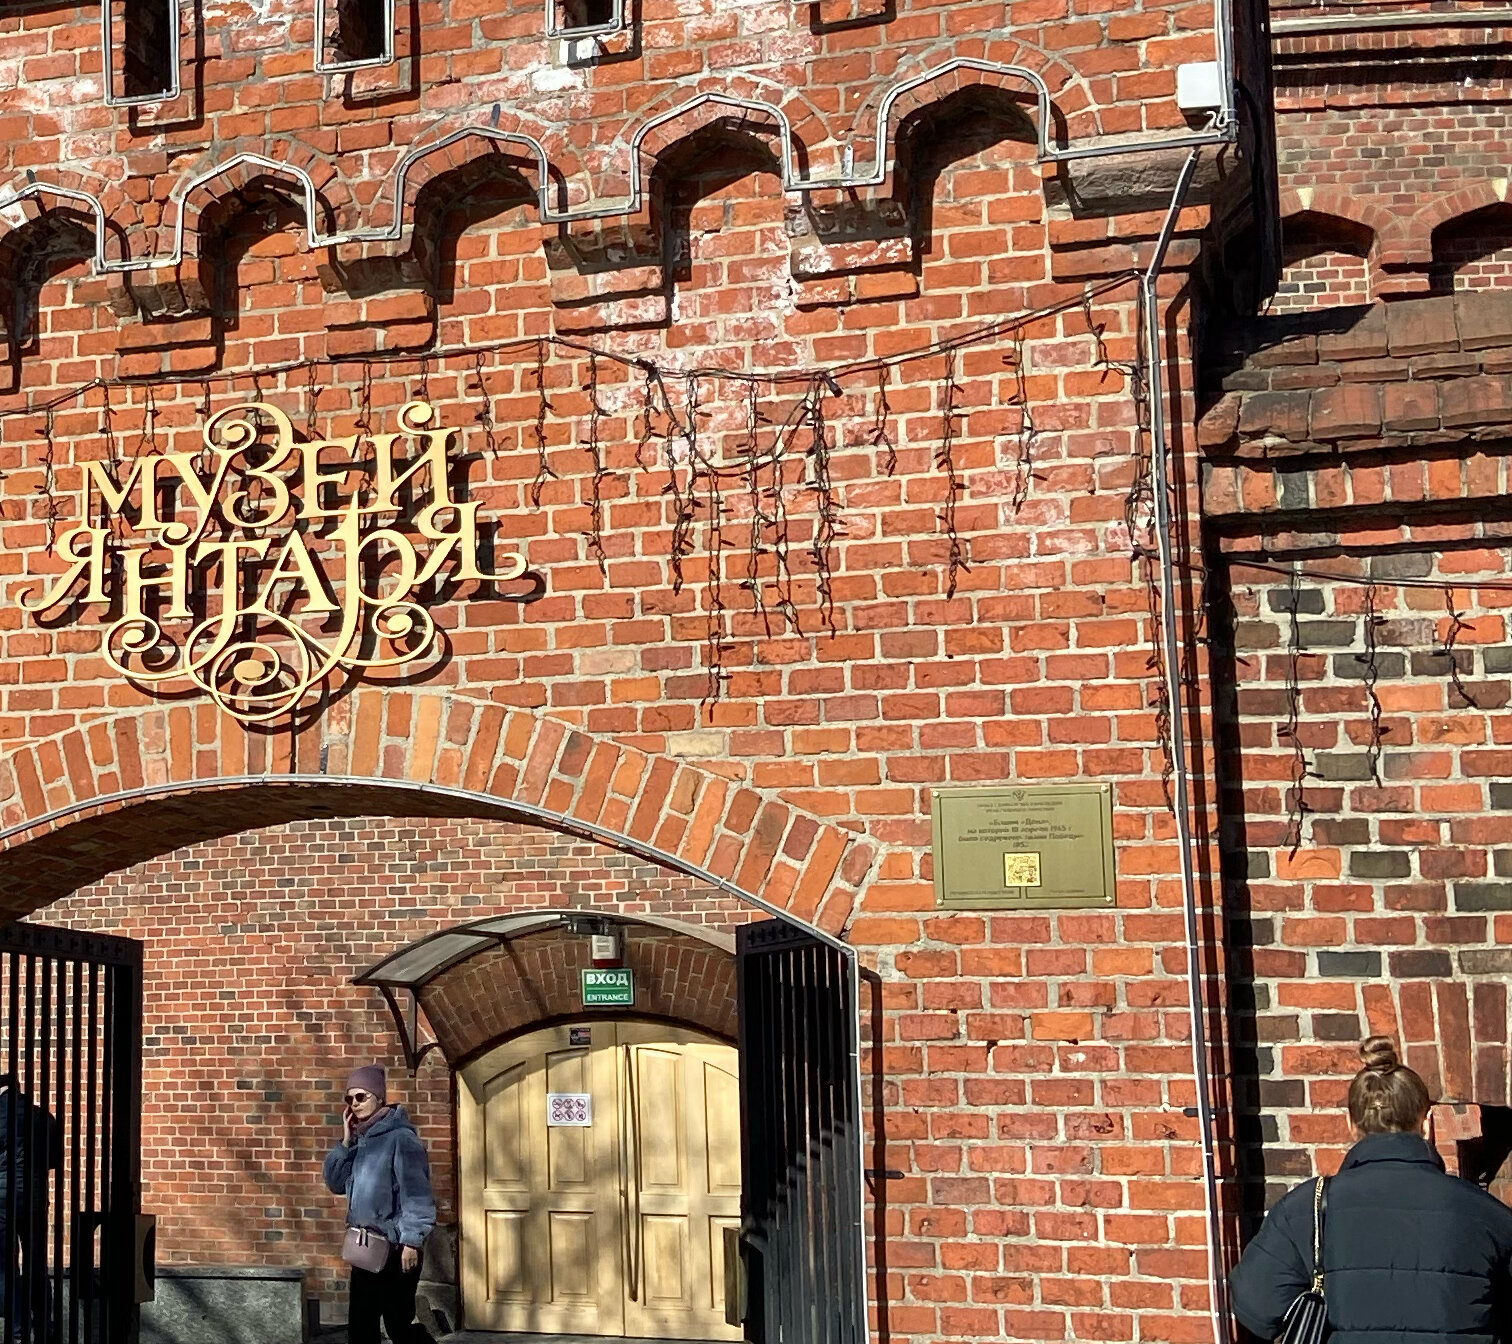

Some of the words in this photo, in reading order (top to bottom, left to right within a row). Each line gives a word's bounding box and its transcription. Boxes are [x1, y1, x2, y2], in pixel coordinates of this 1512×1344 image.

[76, 401, 462, 550] МУЗЕЙ
[15, 491, 530, 722] ЯНТАРЯ
[586, 973, 629, 986] ВХОД
[586, 993, 629, 1002] ENTRANCE
